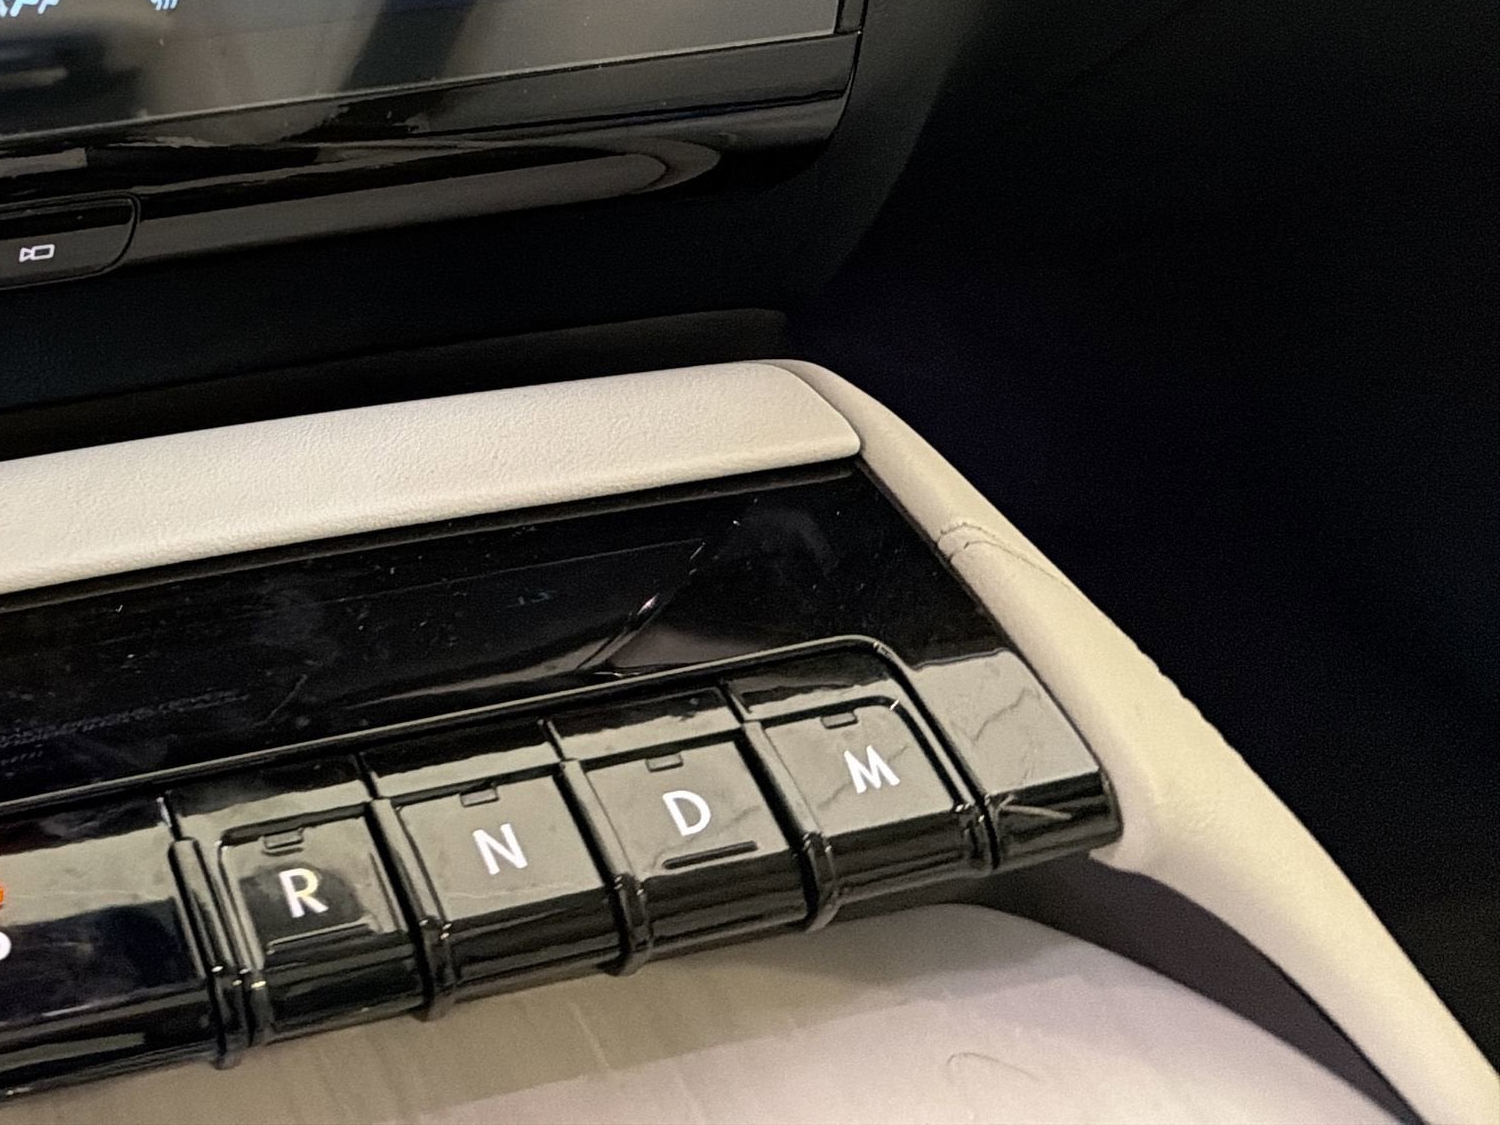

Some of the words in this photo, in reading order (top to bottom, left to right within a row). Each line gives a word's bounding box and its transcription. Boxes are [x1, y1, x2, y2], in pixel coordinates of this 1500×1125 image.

[844, 744, 902, 795] M
[662, 789, 713, 837] D
[471, 823, 529, 876] N
[277, 867, 323, 919] R
